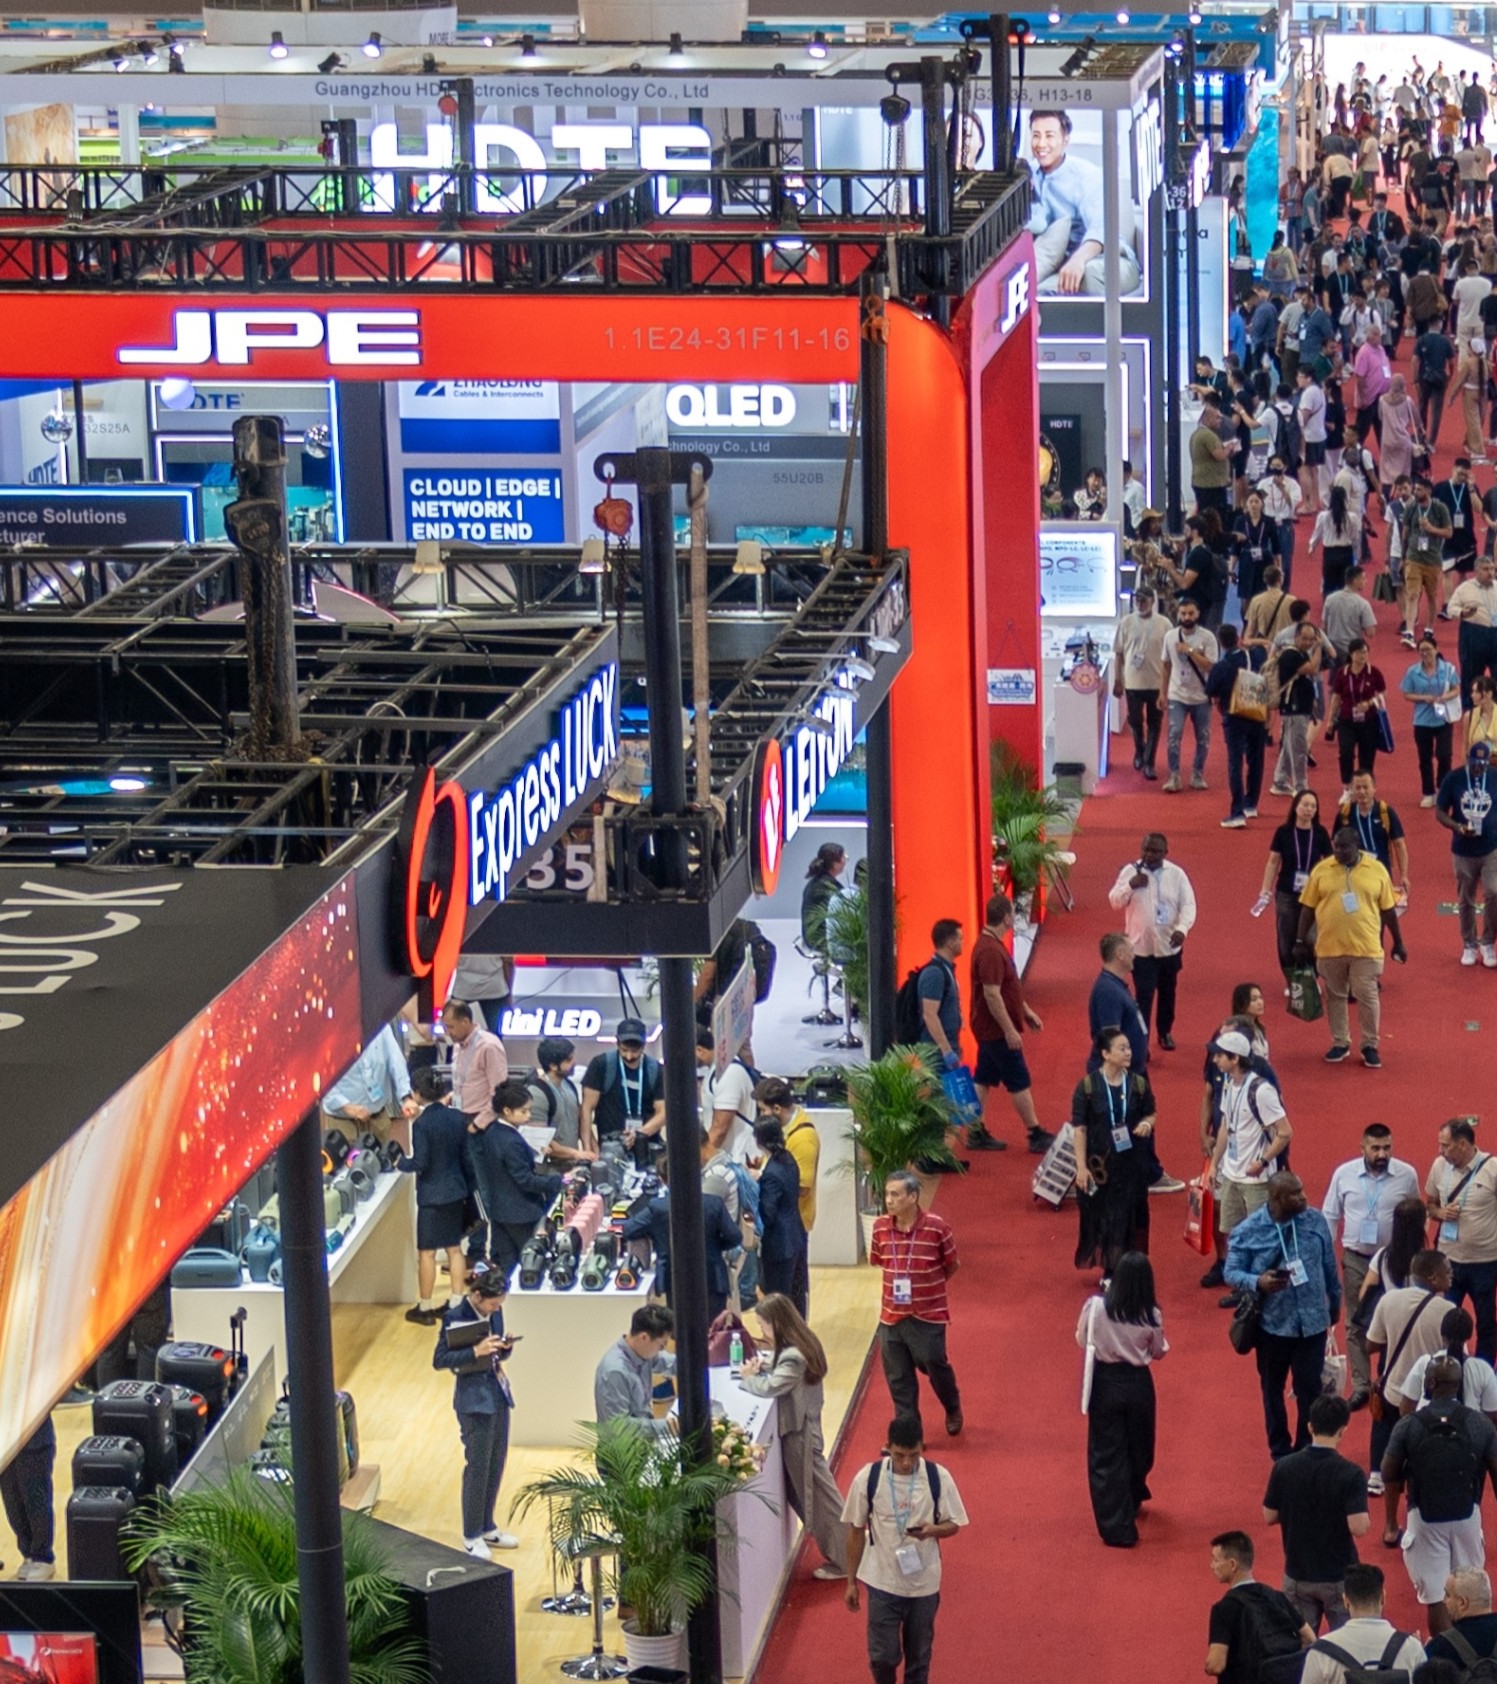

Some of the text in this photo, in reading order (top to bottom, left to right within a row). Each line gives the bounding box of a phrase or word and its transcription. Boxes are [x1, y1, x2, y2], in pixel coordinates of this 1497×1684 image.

[315, 80, 709, 102] Guangzhou Technology Co., Ltd
[1039, 87, 1093, 104] H13-18
[118, 308, 421, 366] JPE
[603, 326, 851, 353] 1.1E24-31F11-16
[453, 390, 544, 398] Cables Interconnects
[665, 382, 797, 428] QLED
[722, 440, 771, 455] Co., Ltd
[410, 478, 551, 498] CLOUD EDGE
[772, 472, 825, 485] 55U20B
[42, 507, 127, 525] Solutions
[411, 500, 514, 519] NETWORK
[412, 522, 533, 541] END TO END
[468, 660, 619, 908] Express LUCK
[544, 1010, 602, 1039] LED
